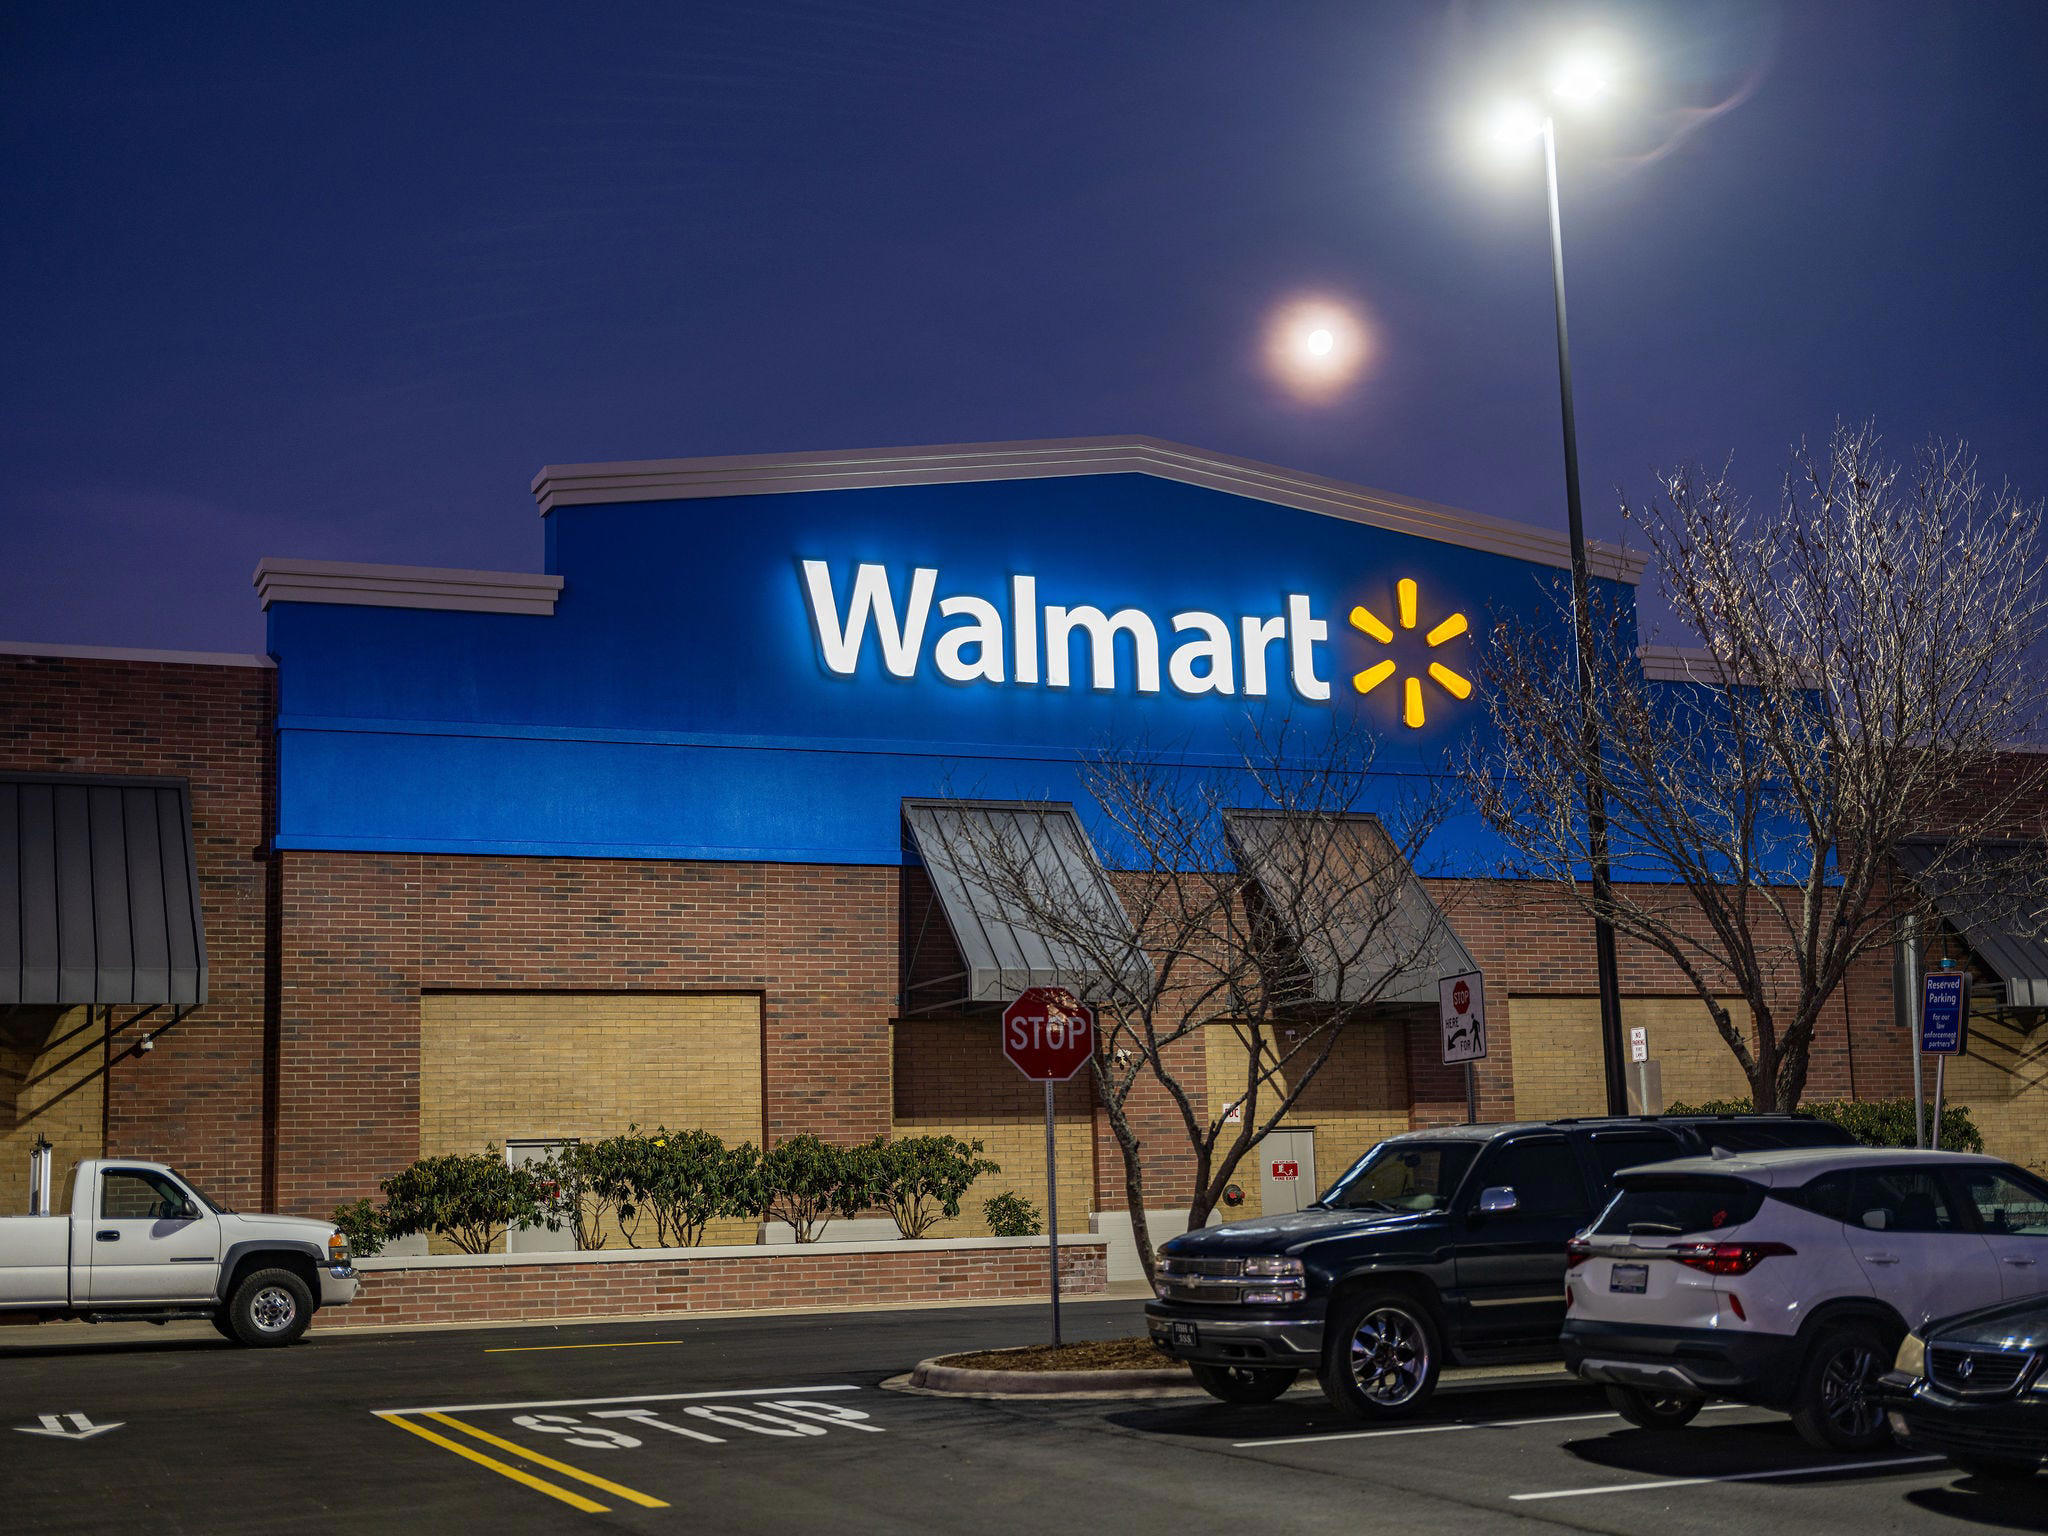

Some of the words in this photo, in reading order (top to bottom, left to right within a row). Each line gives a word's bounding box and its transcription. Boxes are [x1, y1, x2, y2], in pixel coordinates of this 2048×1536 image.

[802, 559, 1330, 700] Walmart
[1927, 978, 1960, 990] Reserved
[1454, 990, 1469, 1005] STOP
[1929, 993, 1957, 1006] Parking
[1932, 1013, 1941, 1021] for
[1010, 1015, 1086, 1050] STOP
[1936, 1022, 1945, 1030] law
[1924, 1031, 1957, 1039] enforcement
[511, 1400, 886, 1449] STOP
